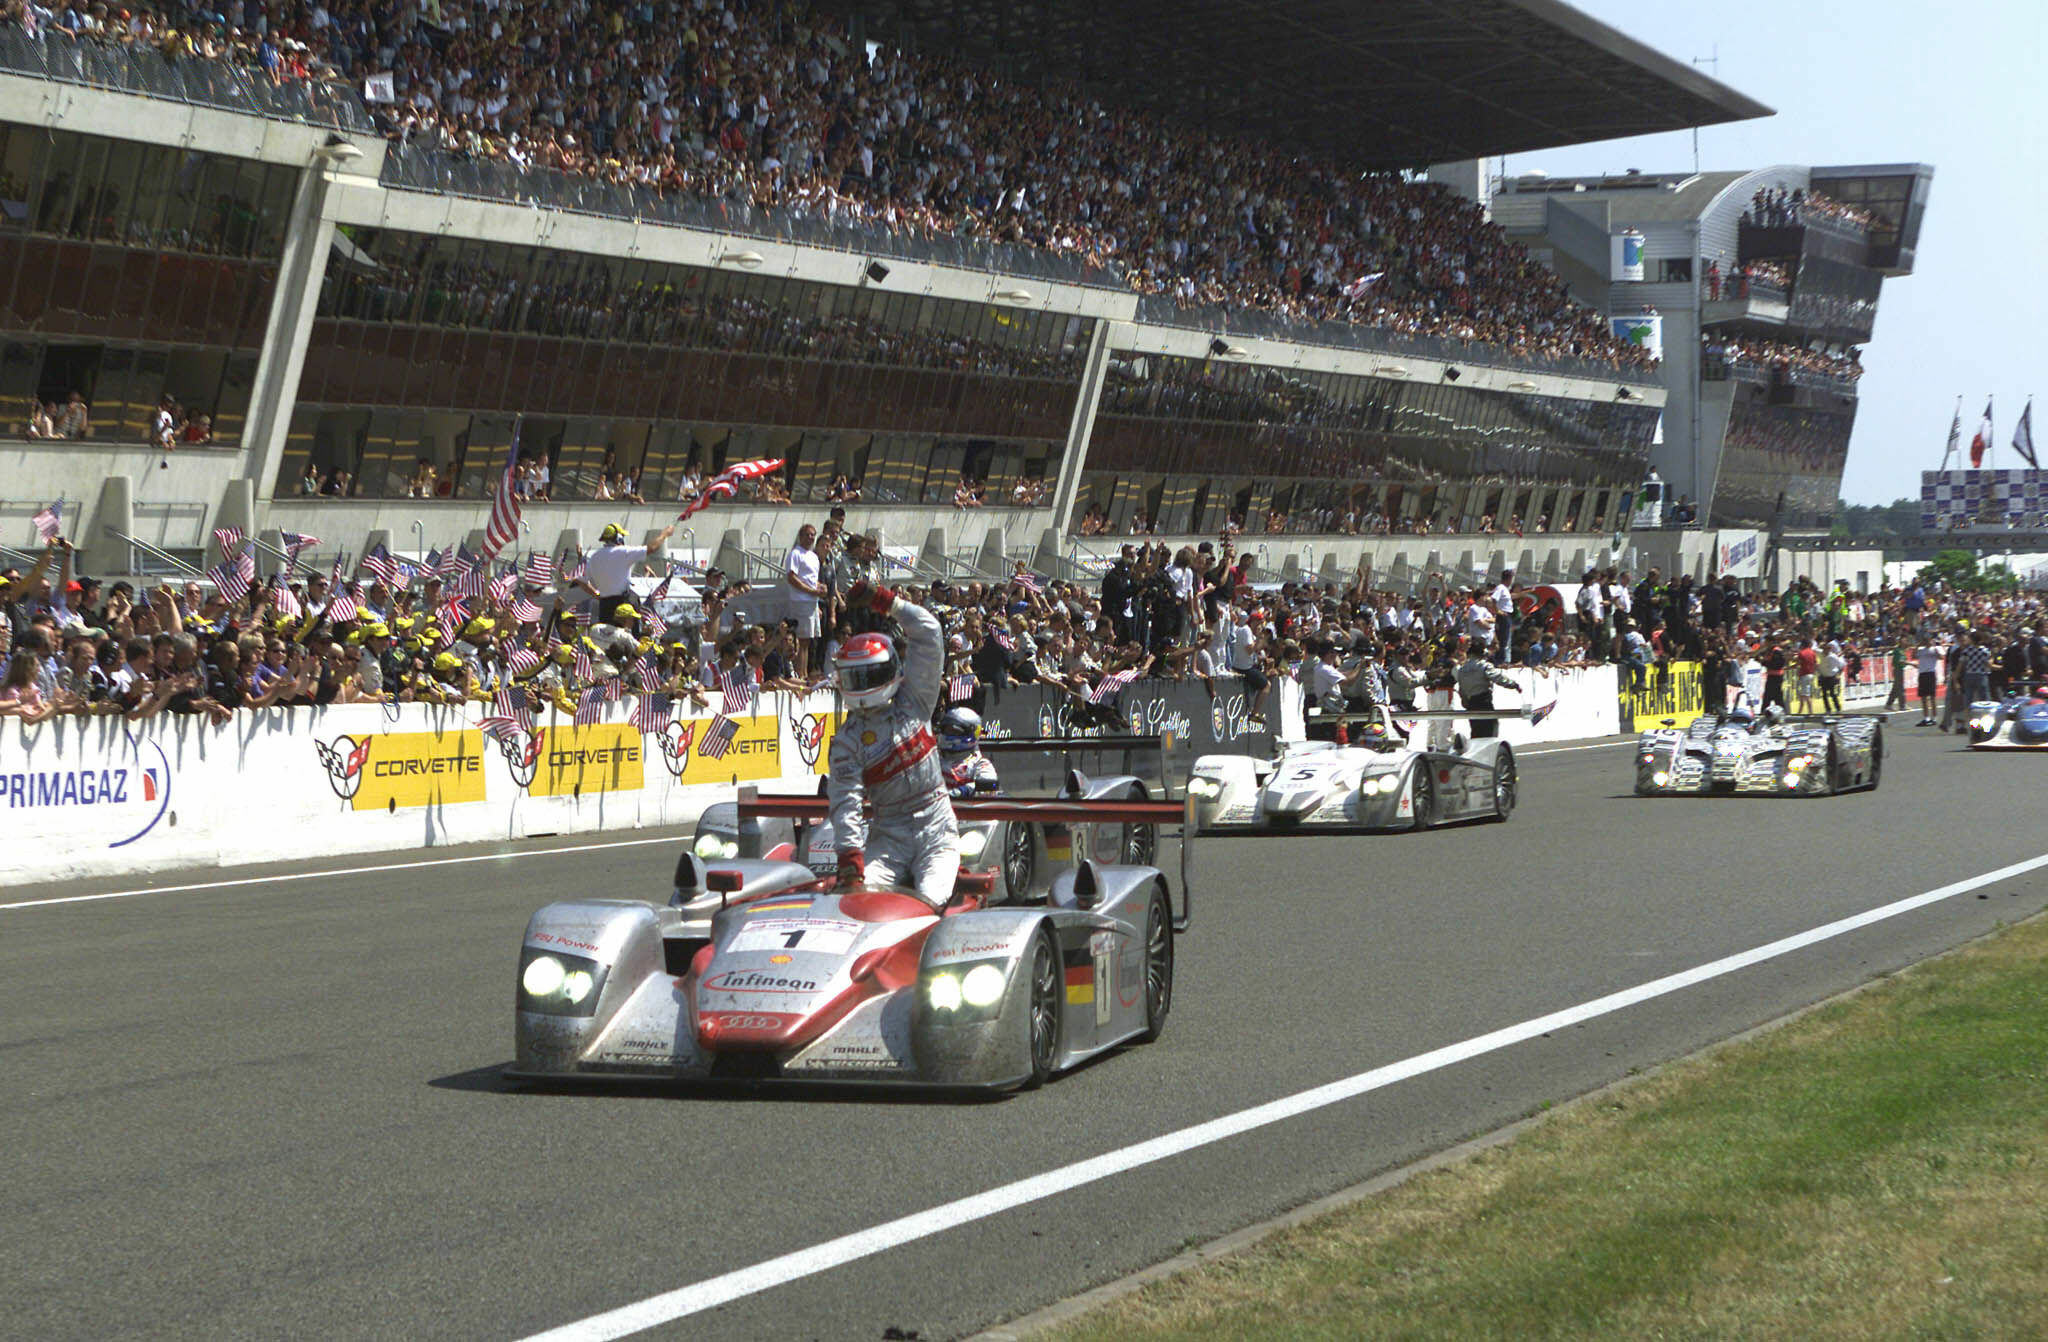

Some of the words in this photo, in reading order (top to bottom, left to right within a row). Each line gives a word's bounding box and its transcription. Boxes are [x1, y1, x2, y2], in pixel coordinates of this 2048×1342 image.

[547, 747, 640, 767] CORVETTE
[698, 738, 777, 757] VETTE
[375, 755, 480, 777] CORVETTE
[1290, 769, 1318, 781] 5
[0, 769, 128, 808] PRIMAGAZ
[1076, 832, 1084, 863] 3
[780, 930, 807, 948] 1
